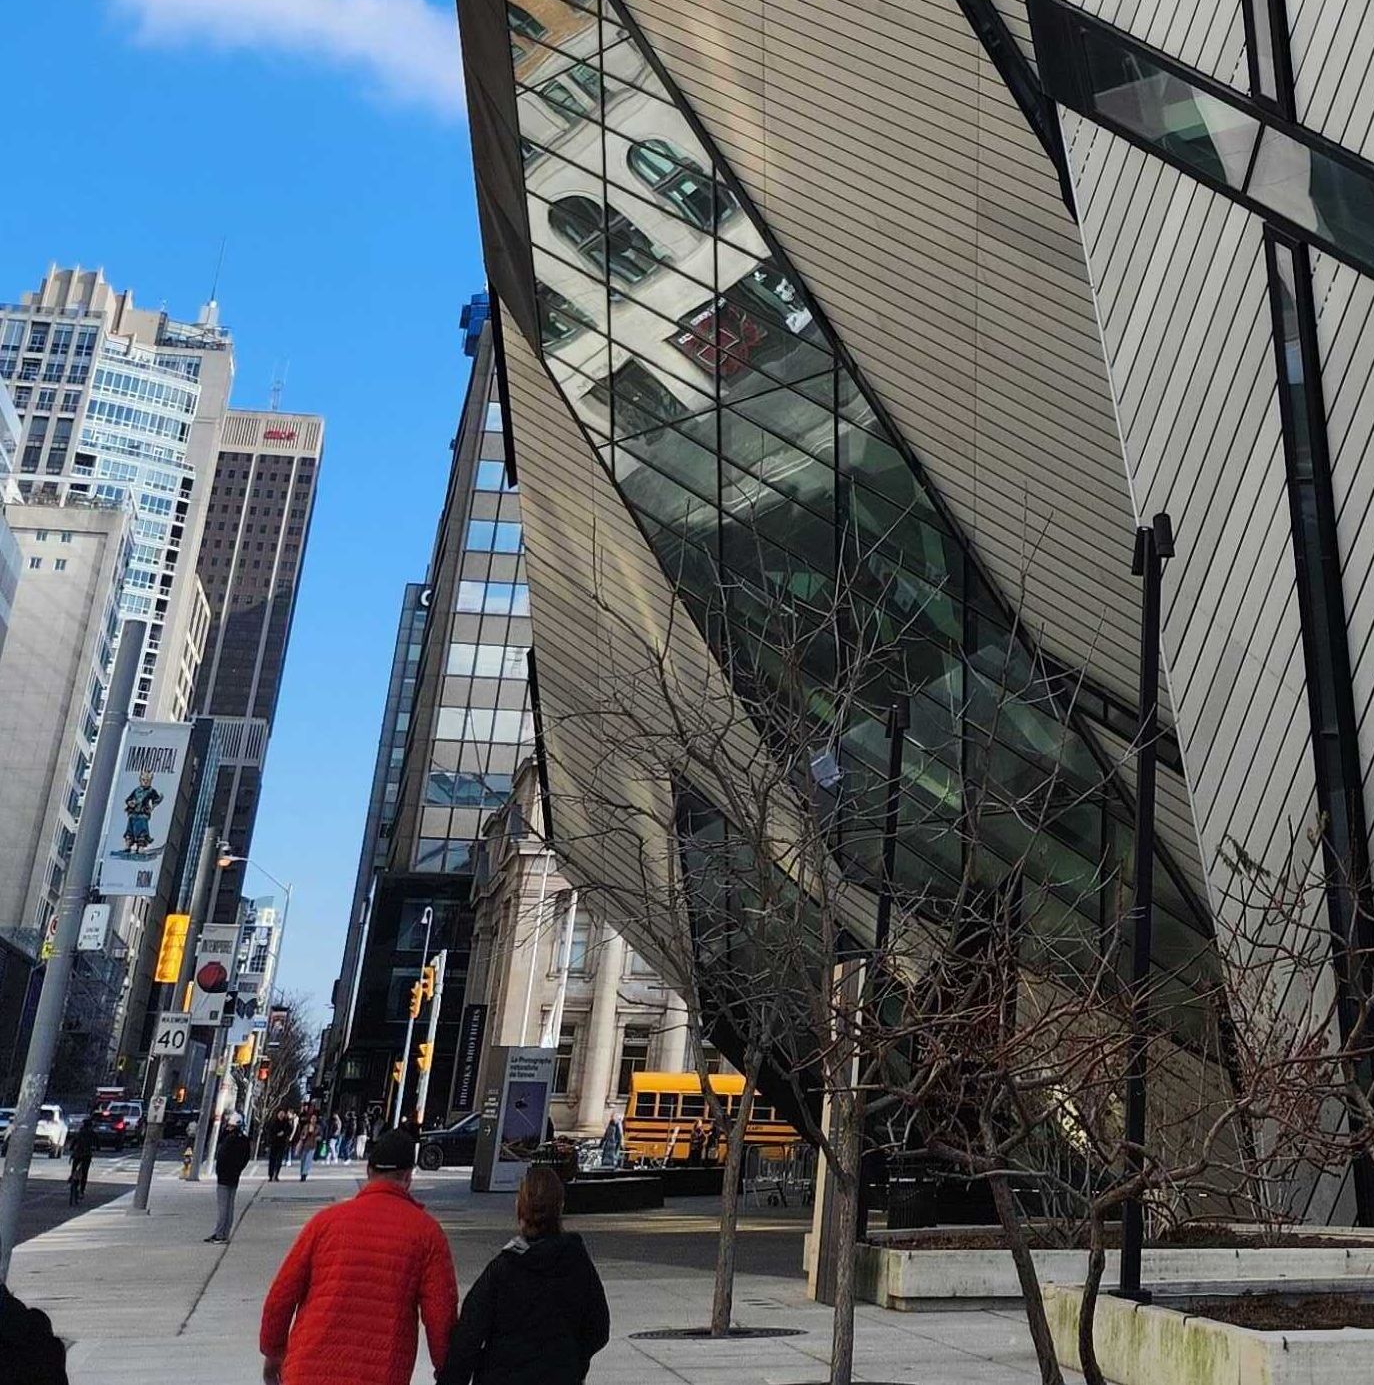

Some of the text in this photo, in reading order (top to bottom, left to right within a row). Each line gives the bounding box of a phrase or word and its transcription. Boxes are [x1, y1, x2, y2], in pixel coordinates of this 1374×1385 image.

[125, 745, 178, 774] IMMORTAL
[161, 1016, 189, 1024] MAXIMUM
[157, 1030, 185, 1049] 40
[460, 1008, 481, 1106] BROOKS BROTHERS
